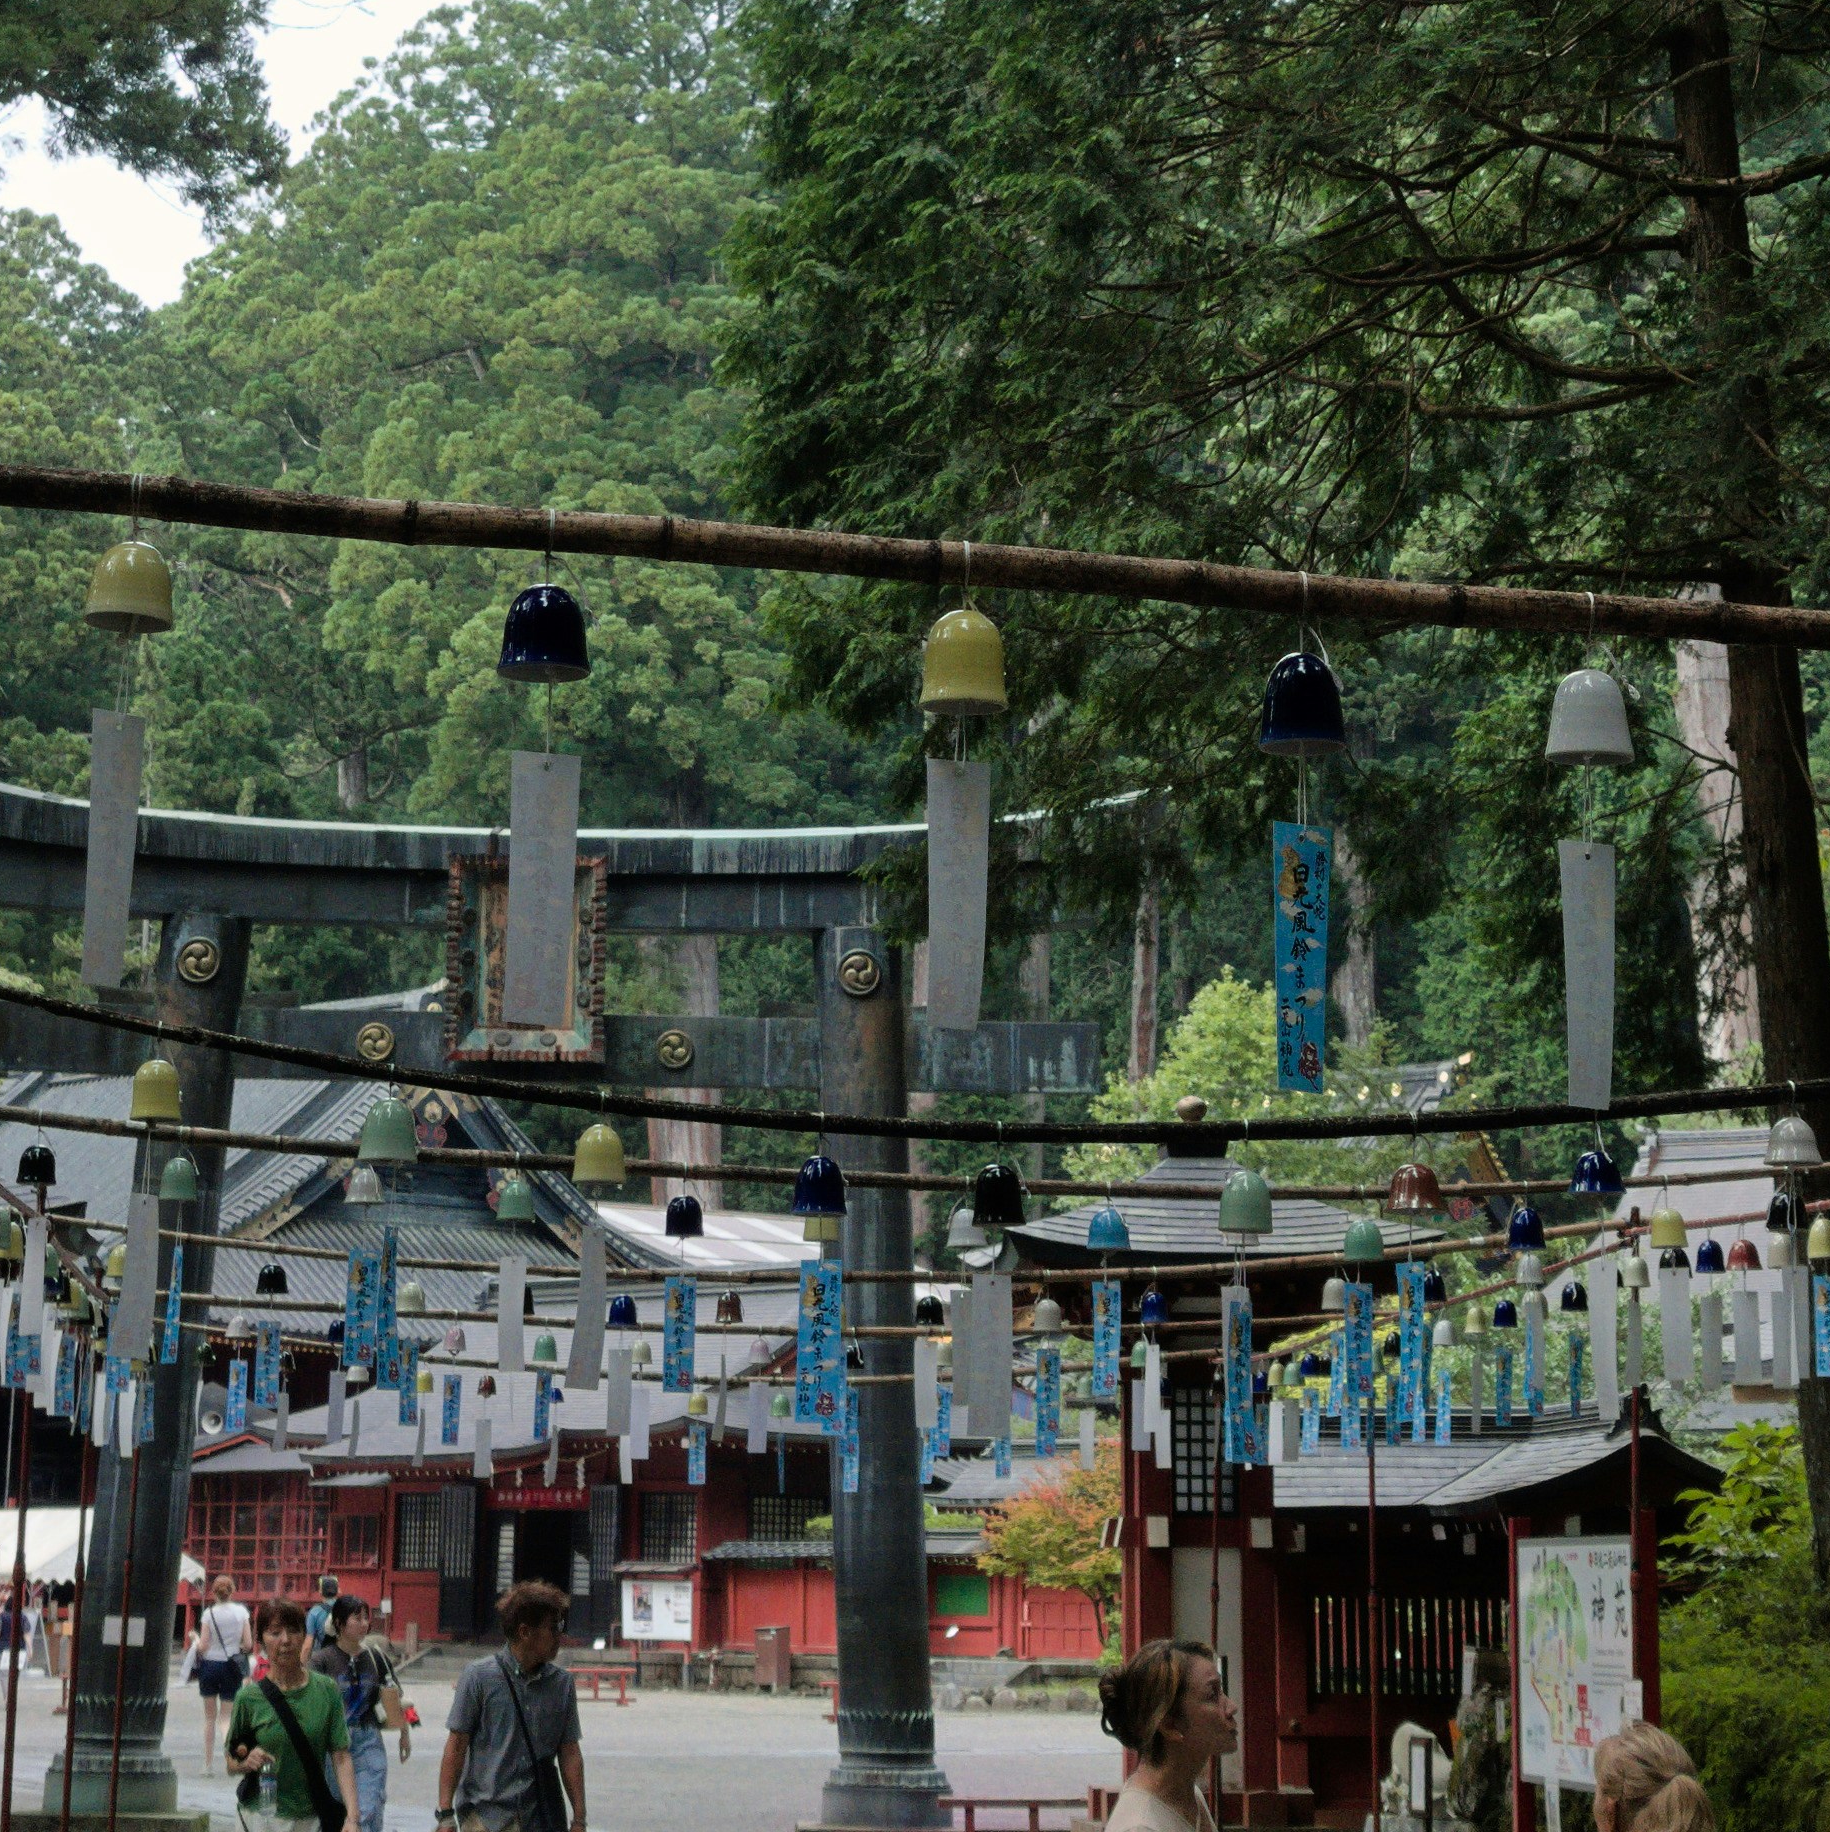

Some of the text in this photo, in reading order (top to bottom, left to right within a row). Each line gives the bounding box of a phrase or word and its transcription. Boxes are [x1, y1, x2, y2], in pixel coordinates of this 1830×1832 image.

[1290, 863, 1316, 1043] 日光風鈴まつり
